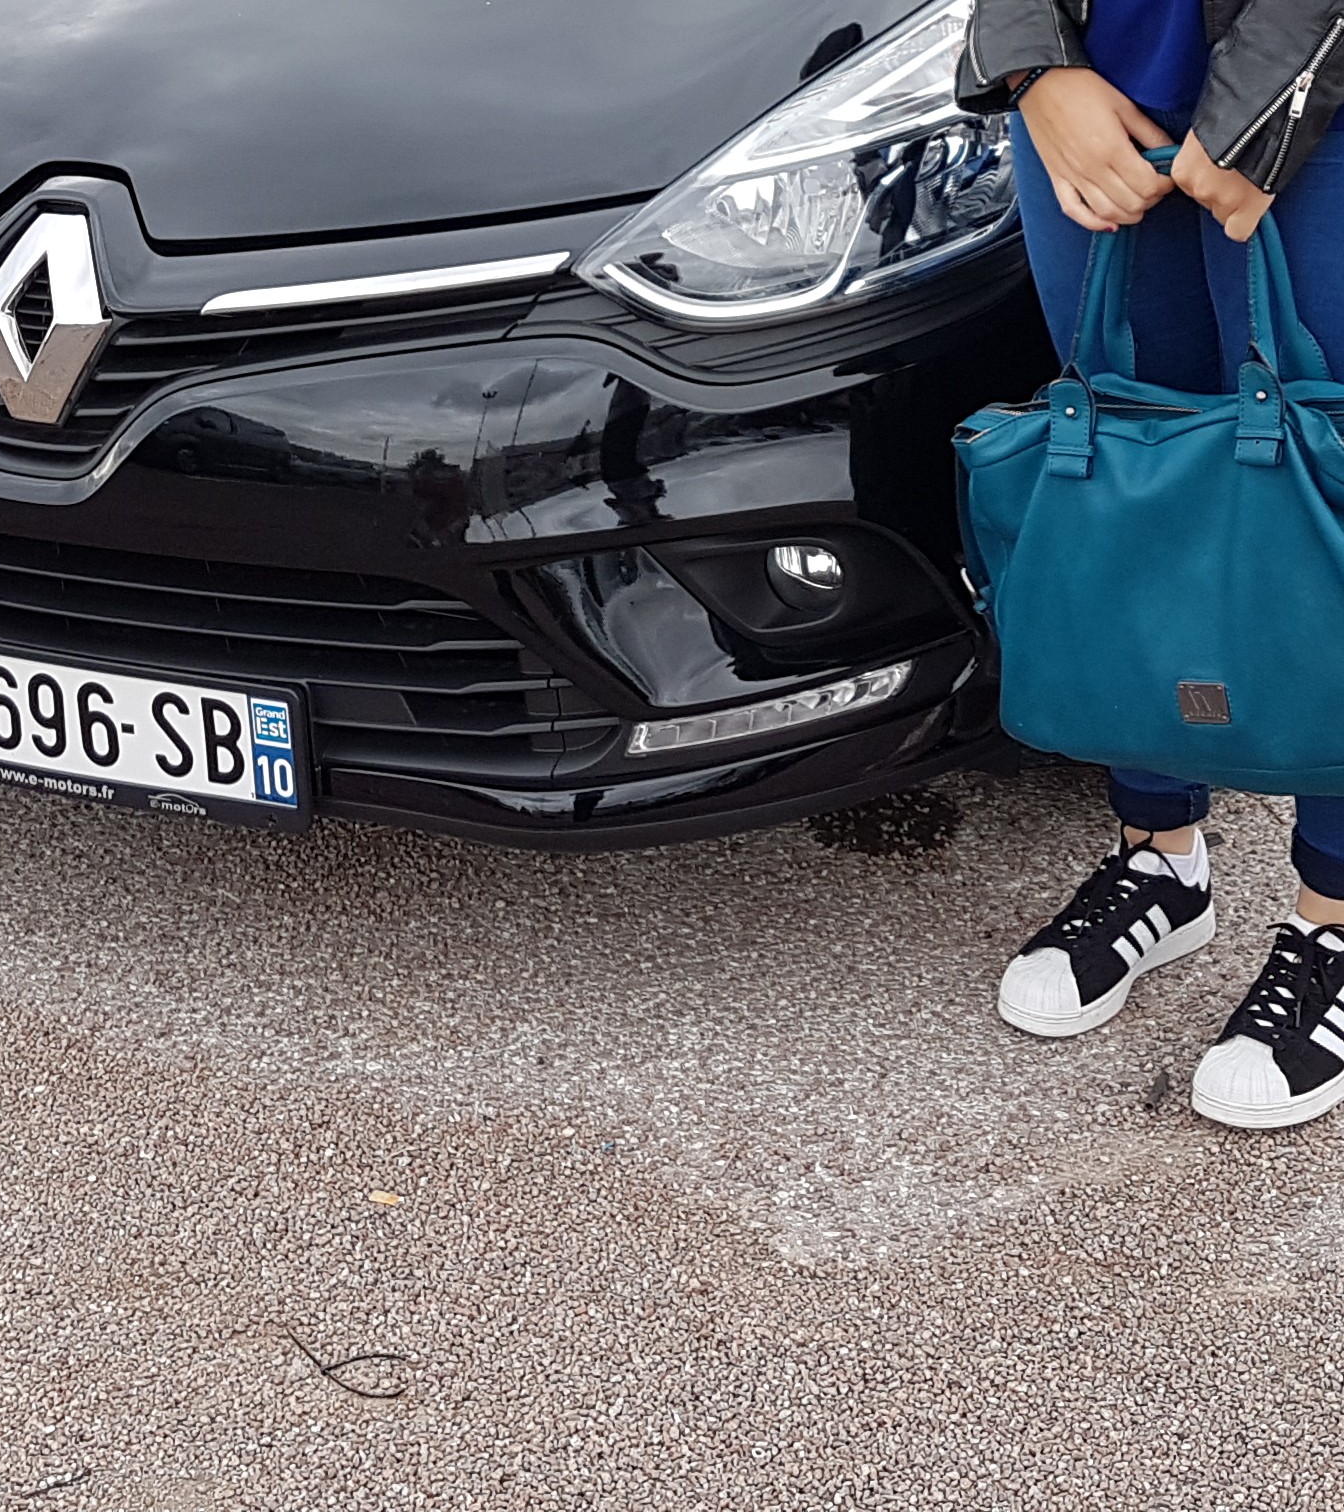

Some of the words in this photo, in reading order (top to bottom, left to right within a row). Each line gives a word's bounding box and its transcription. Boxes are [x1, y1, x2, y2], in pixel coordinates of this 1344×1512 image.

[256, 707, 285, 719] Grand
[256, 717, 287, 738] Est
[257, 755, 294, 798] 10
